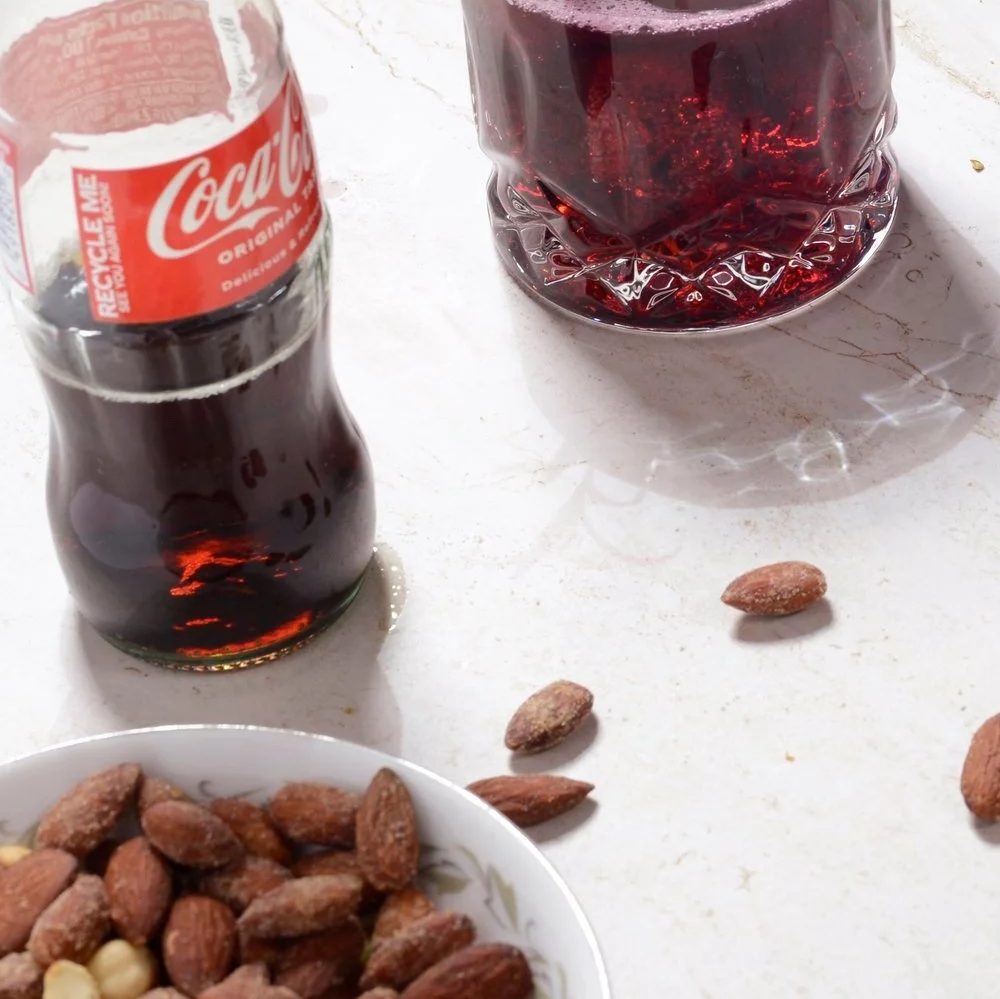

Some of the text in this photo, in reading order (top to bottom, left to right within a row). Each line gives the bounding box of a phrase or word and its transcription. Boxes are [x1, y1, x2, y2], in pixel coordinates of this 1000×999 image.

[146, 70, 315, 259] Coca-Co
[77, 172, 119, 319] RECYCLE ME
[217, 203, 302, 264] ORIGINAL
[110, 261, 126, 289] YOU
[221, 250, 287, 292] Delicious
